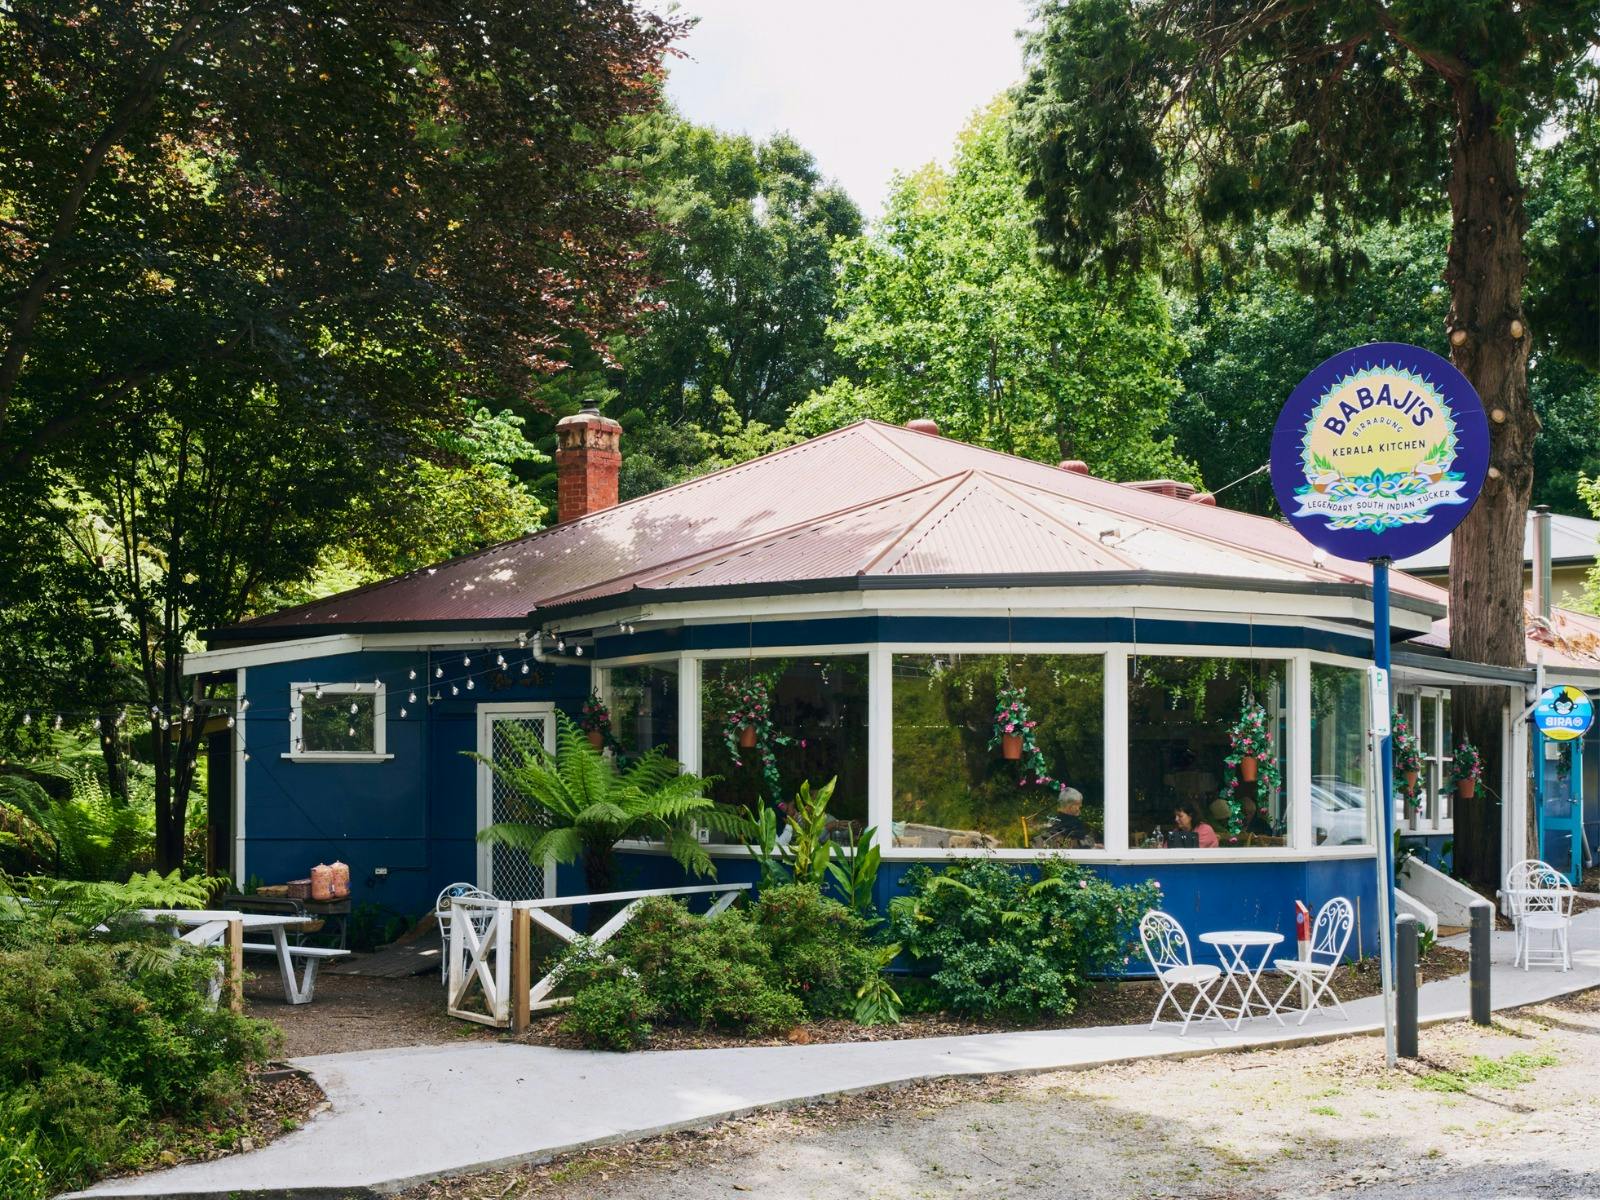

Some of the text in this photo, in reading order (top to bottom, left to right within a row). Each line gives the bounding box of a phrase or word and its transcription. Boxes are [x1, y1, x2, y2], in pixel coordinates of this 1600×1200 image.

[1323, 383, 1434, 436] BABAJI'S
[1352, 417, 1403, 437] BIRRARUNG
[1332, 440, 1426, 457] KERALA KITCHEN
[1307, 490, 1451, 513] LEGENDARY SOUTH INDIAN TUCKER
